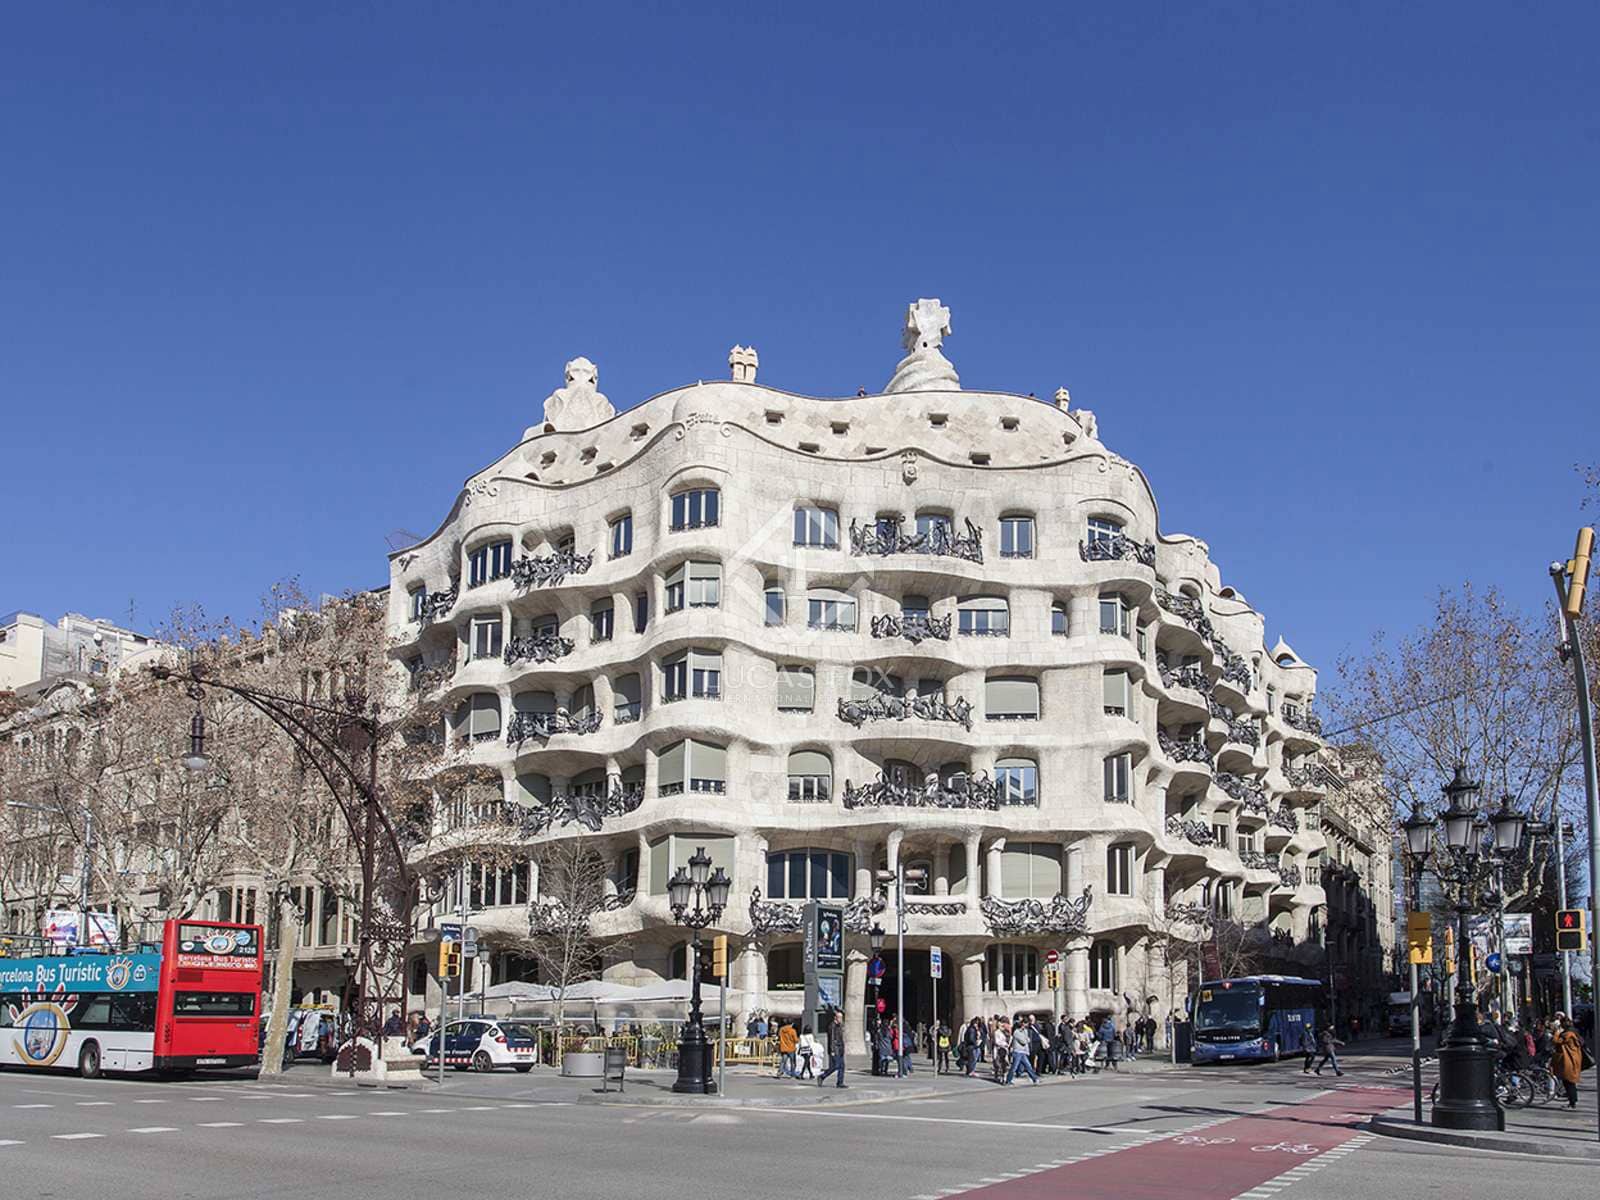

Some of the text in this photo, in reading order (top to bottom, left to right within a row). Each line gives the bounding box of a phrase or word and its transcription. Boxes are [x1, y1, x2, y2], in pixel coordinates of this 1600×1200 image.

[0, 961, 102, 983] rcelona Bus Turístic
